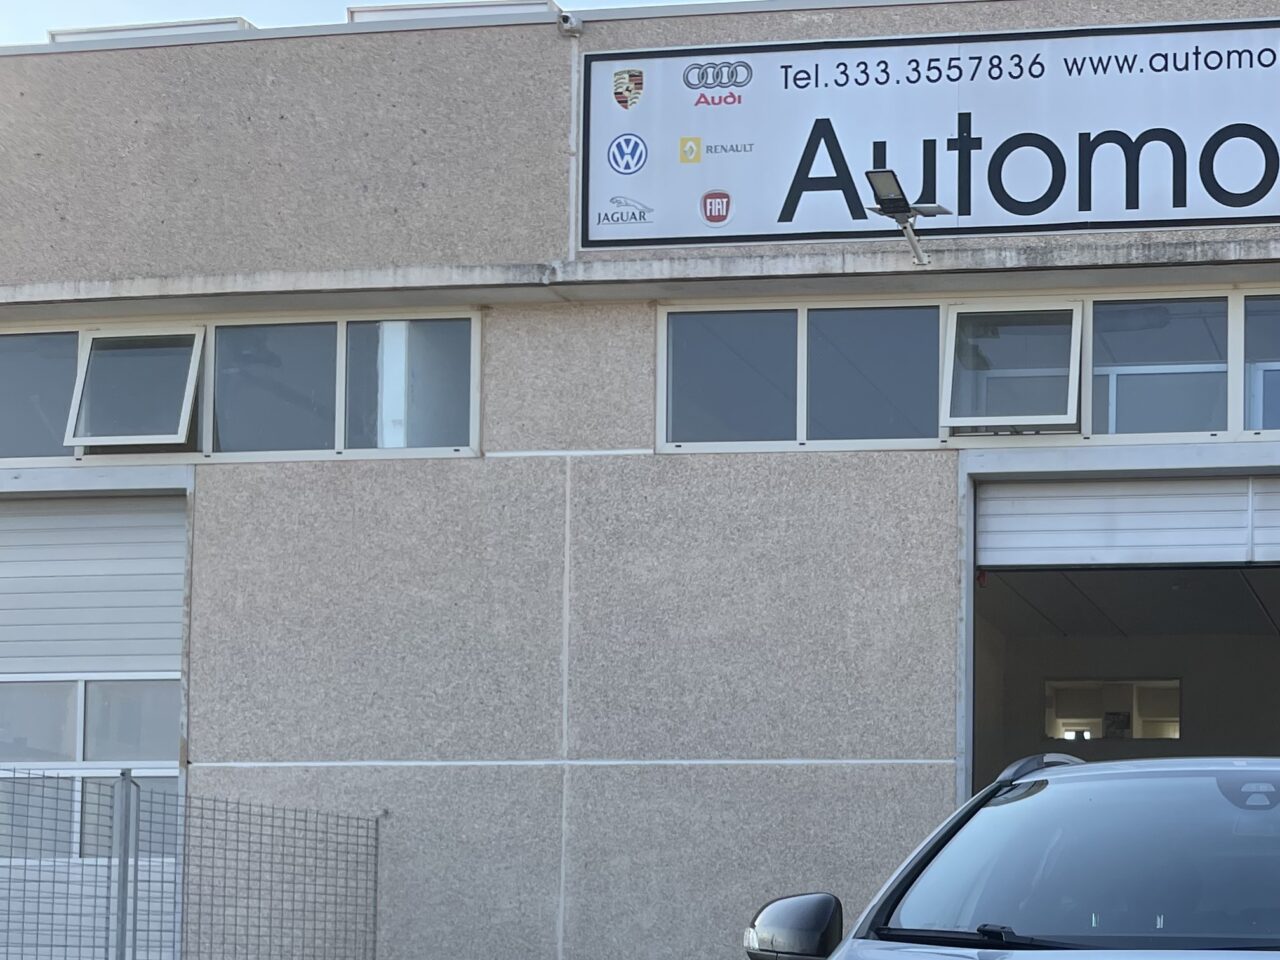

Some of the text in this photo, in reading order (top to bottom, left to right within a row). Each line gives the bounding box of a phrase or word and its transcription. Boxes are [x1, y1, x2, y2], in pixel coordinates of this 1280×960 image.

[780, 53, 1045, 90] Tel.333.3557836
[694, 91, 742, 107] Audi
[705, 143, 755, 154] RENAULT
[706, 198, 728, 217] FIAT
[596, 211, 647, 226] JAGUAR
